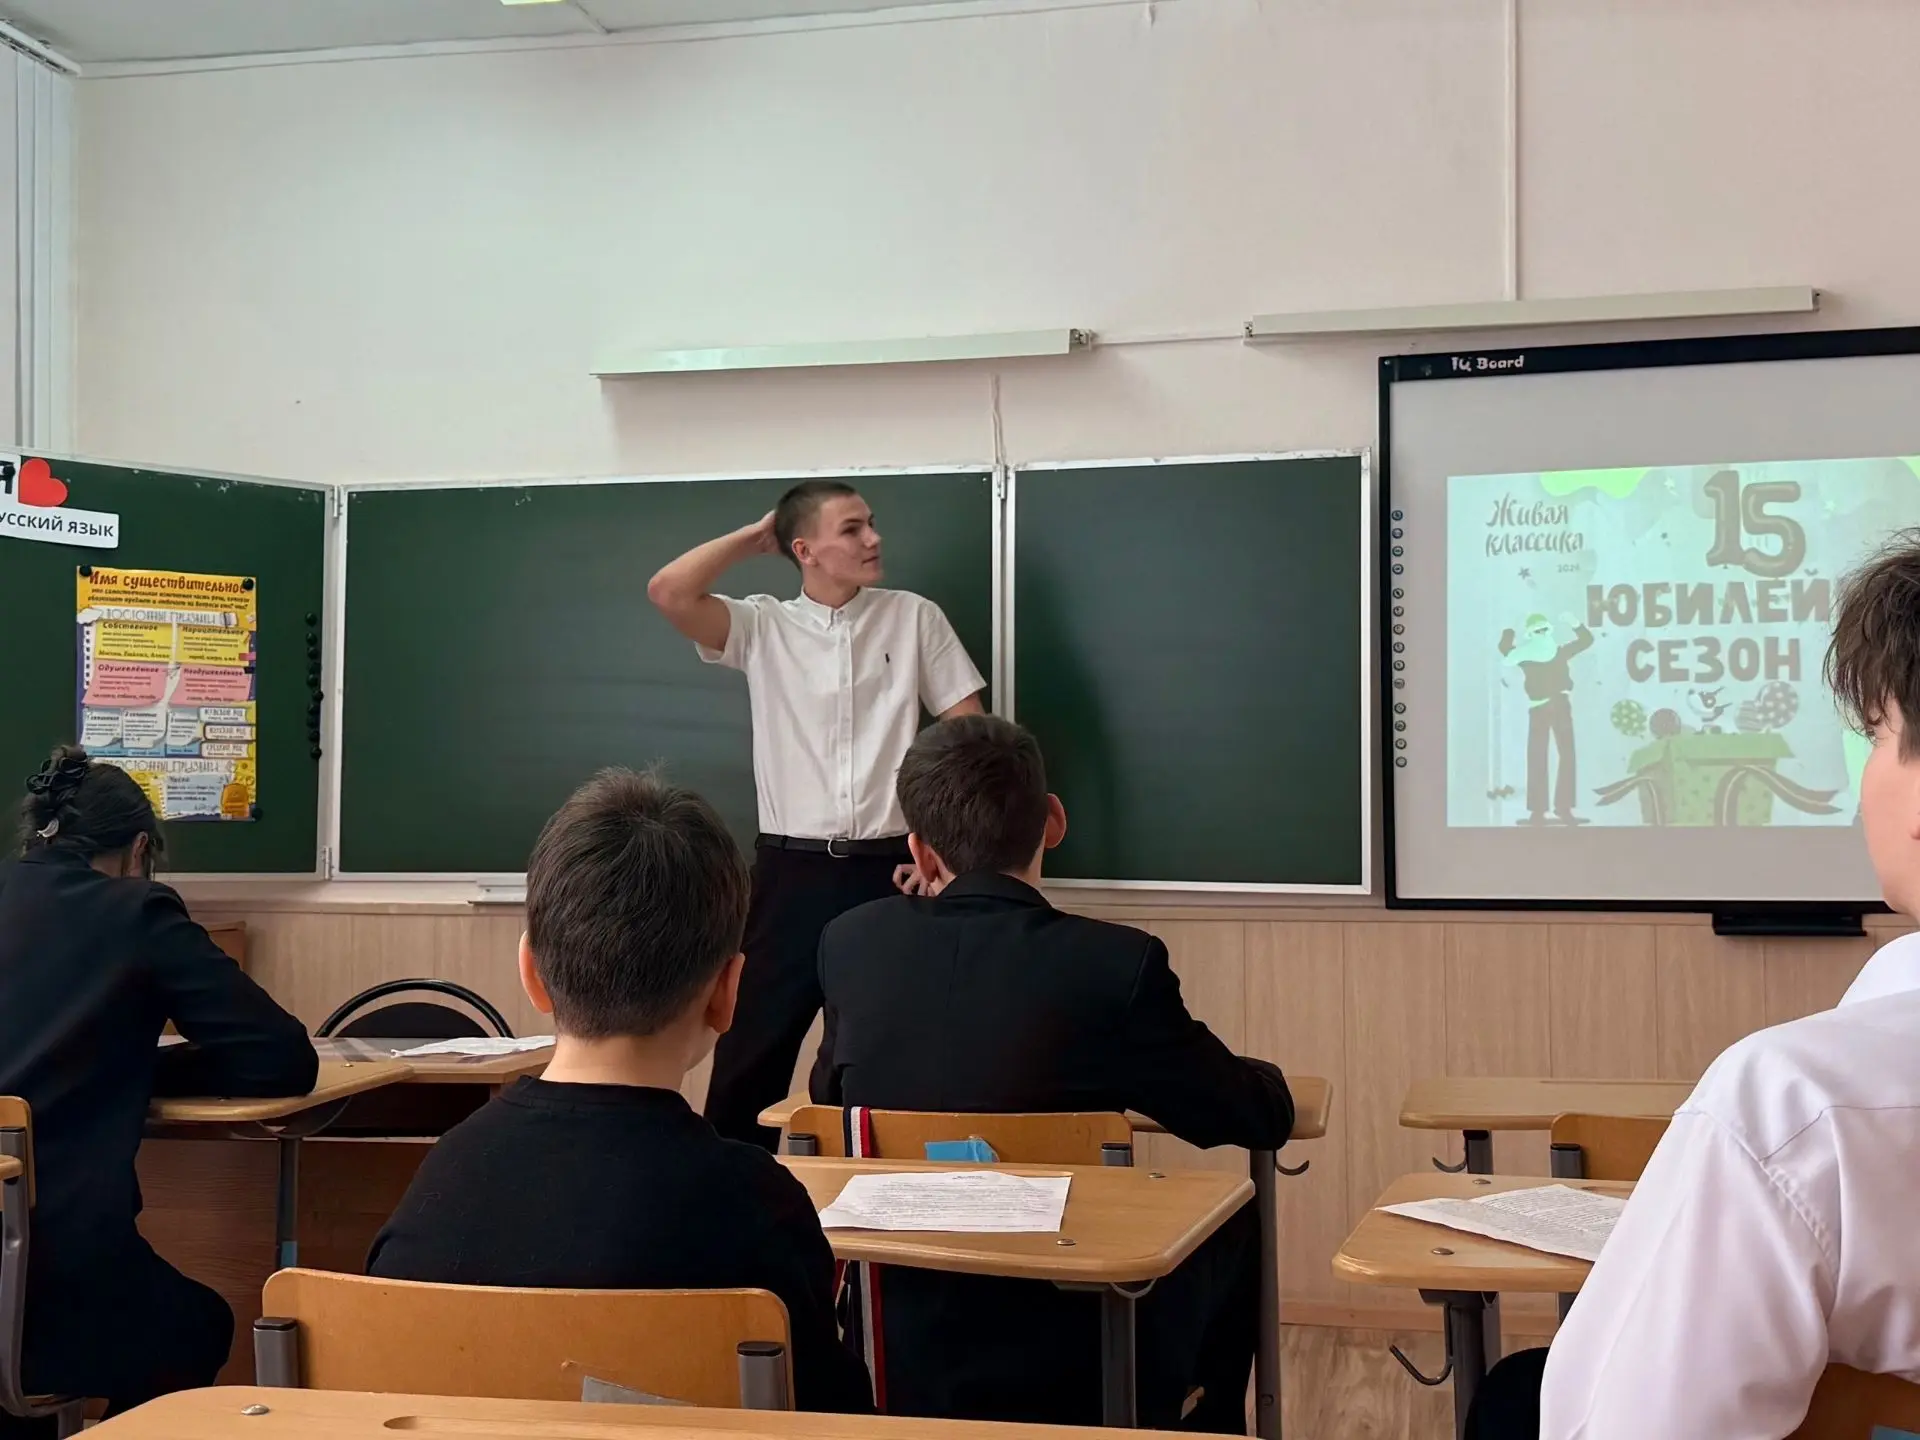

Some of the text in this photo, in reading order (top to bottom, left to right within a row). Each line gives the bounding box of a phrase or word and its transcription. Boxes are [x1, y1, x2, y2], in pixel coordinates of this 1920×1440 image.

[1477, 355, 1524, 370] Board
[1485, 492, 1569, 528] Живая
[1703, 470, 1806, 578] 15
[68, 521, 114, 537] ЯЗЫК
[1485, 531, 1584, 557] классика
[89, 571, 118, 585] Имя
[1586, 568, 1836, 628] ЮБИЛЕЙ
[1626, 636, 1802, 683] СЕЗОН
